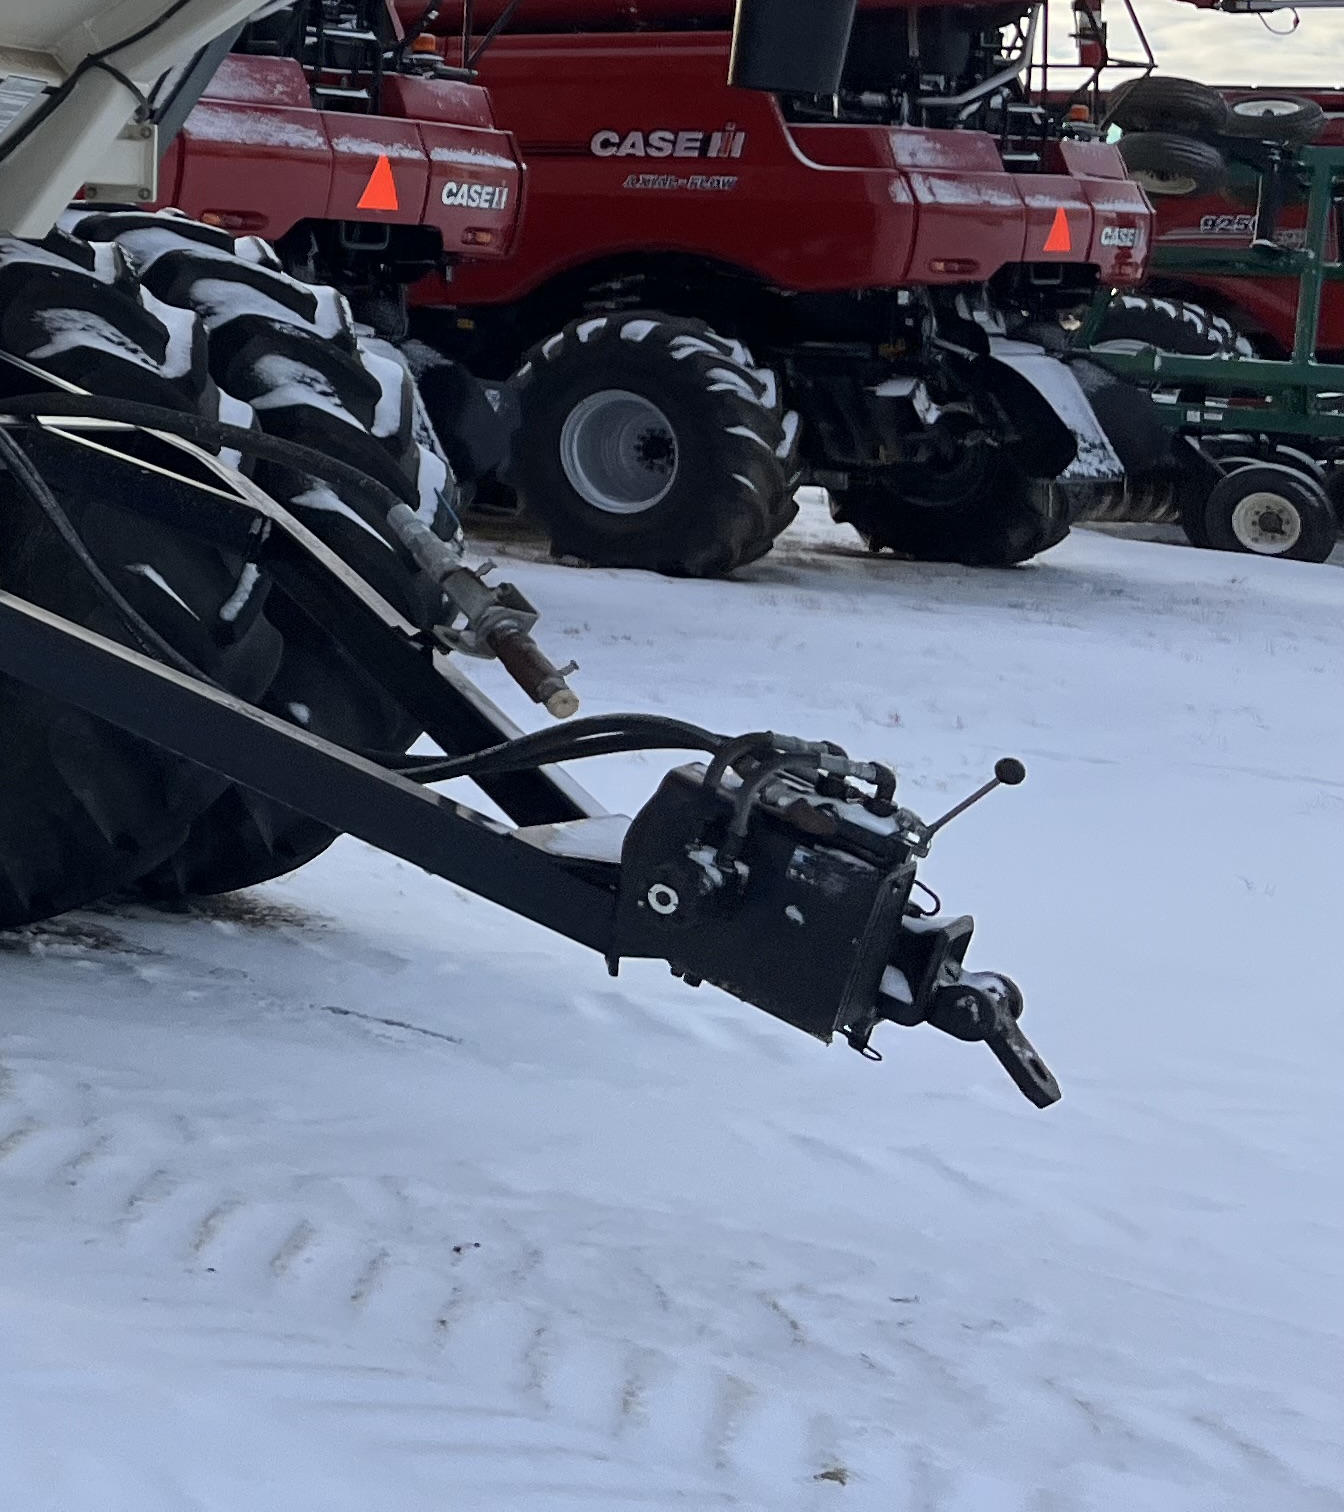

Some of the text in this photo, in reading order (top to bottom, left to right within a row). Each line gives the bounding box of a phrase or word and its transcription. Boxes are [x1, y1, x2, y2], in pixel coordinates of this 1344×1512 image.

[590, 130, 703, 157] CASE
[441, 182, 493, 209] CASE
[1101, 226, 1135, 247] CASE
